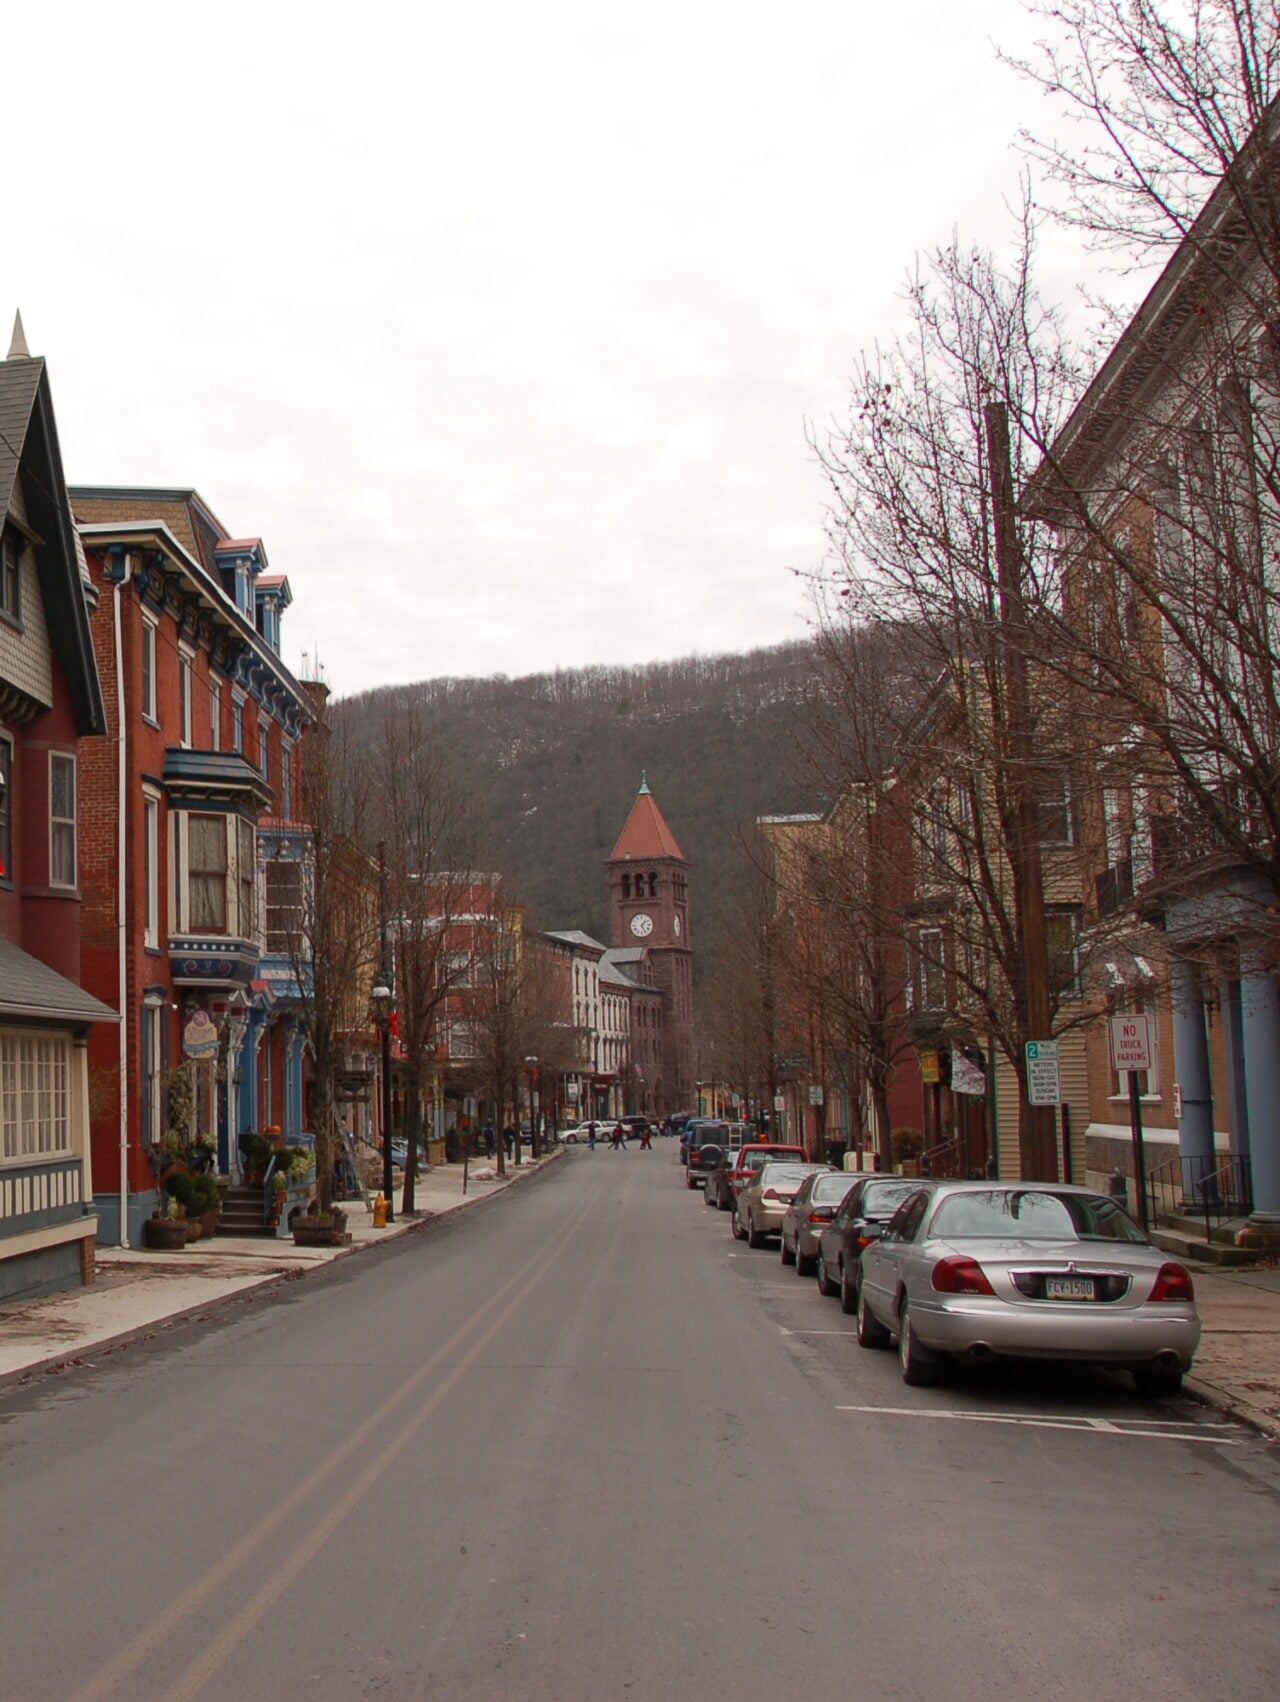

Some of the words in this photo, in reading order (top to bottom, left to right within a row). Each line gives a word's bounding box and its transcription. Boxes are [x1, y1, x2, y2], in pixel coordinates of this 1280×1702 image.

[1123, 1025, 1136, 1037] NO
[1120, 1040, 1141, 1049] TRUCK
[1028, 1044, 1037, 1057] 2
[1117, 1052, 1147, 1062] PARKING
